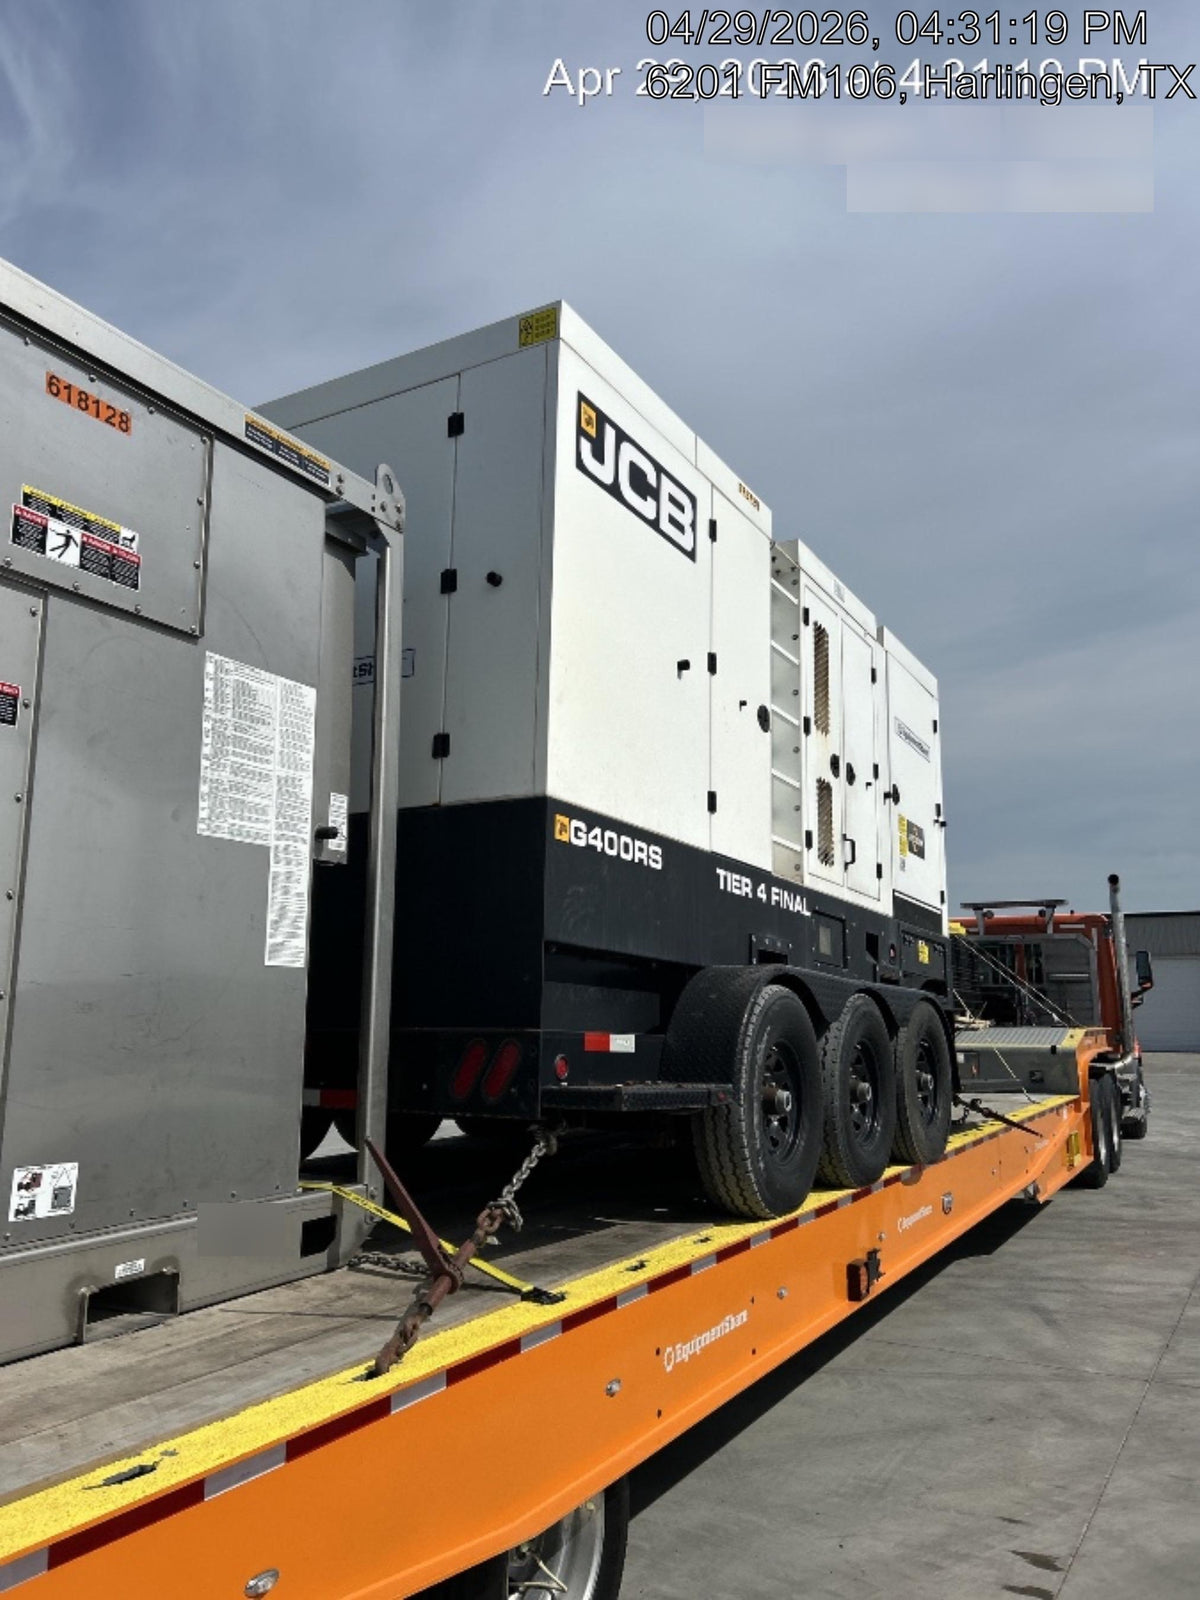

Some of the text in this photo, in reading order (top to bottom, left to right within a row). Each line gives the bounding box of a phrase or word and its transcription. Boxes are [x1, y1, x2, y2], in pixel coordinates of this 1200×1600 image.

[48, 375, 130, 433] 618128
[579, 422, 696, 553] JCB
[570, 819, 663, 871] G400RS
[716, 867, 812, 917] TIER 4 FINAL
